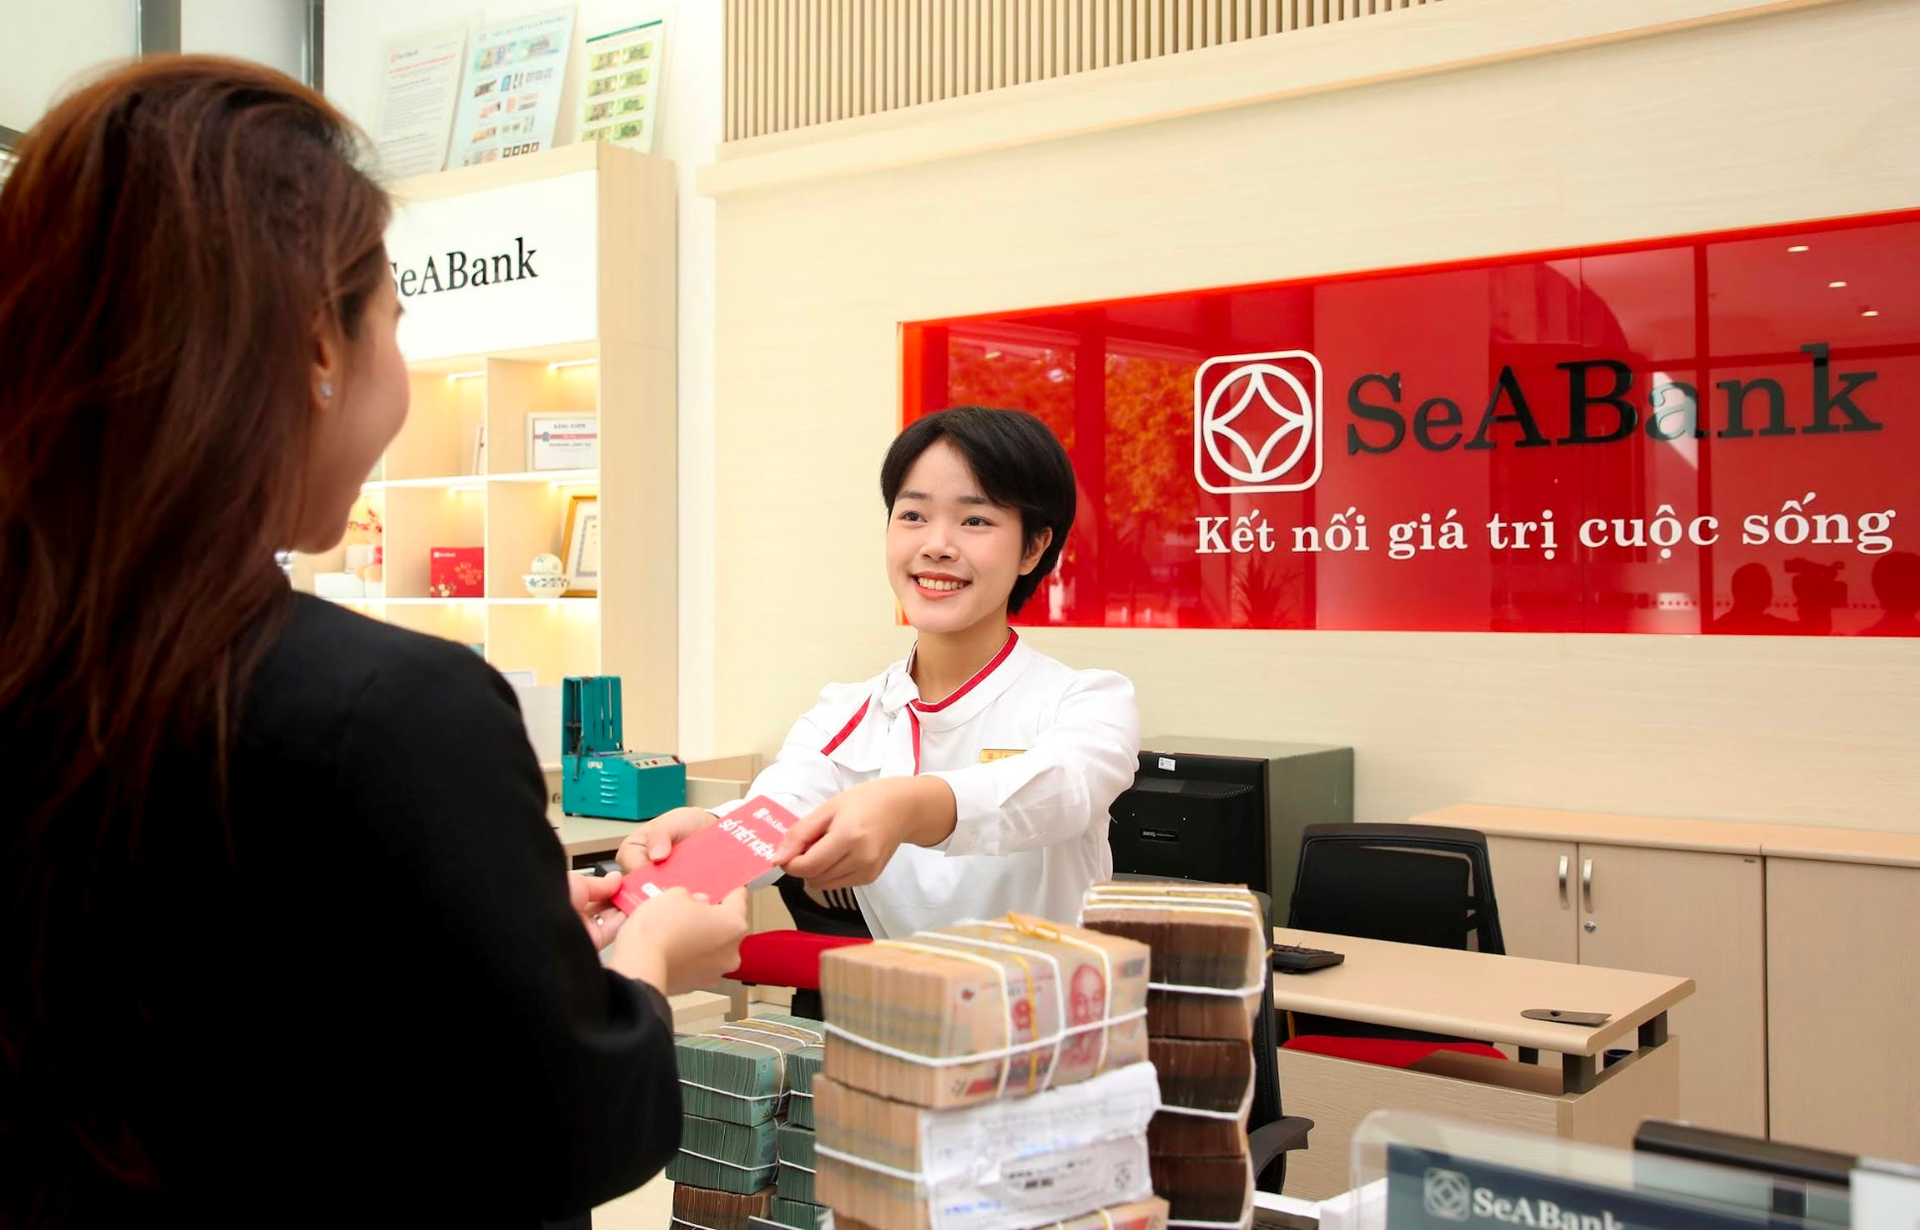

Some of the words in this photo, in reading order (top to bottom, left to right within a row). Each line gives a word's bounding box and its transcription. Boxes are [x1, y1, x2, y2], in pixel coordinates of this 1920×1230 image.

[1347, 342, 1883, 455] SeABank
[1195, 509, 1275, 554] Kết
[1291, 507, 1369, 552] nối
[1388, 508, 1467, 560] giá
[1486, 510, 1558, 560] trị
[1579, 504, 1719, 559] cuộc
[1742, 492, 1896, 554] sống
[1472, 1187, 1624, 1230] SeABank
